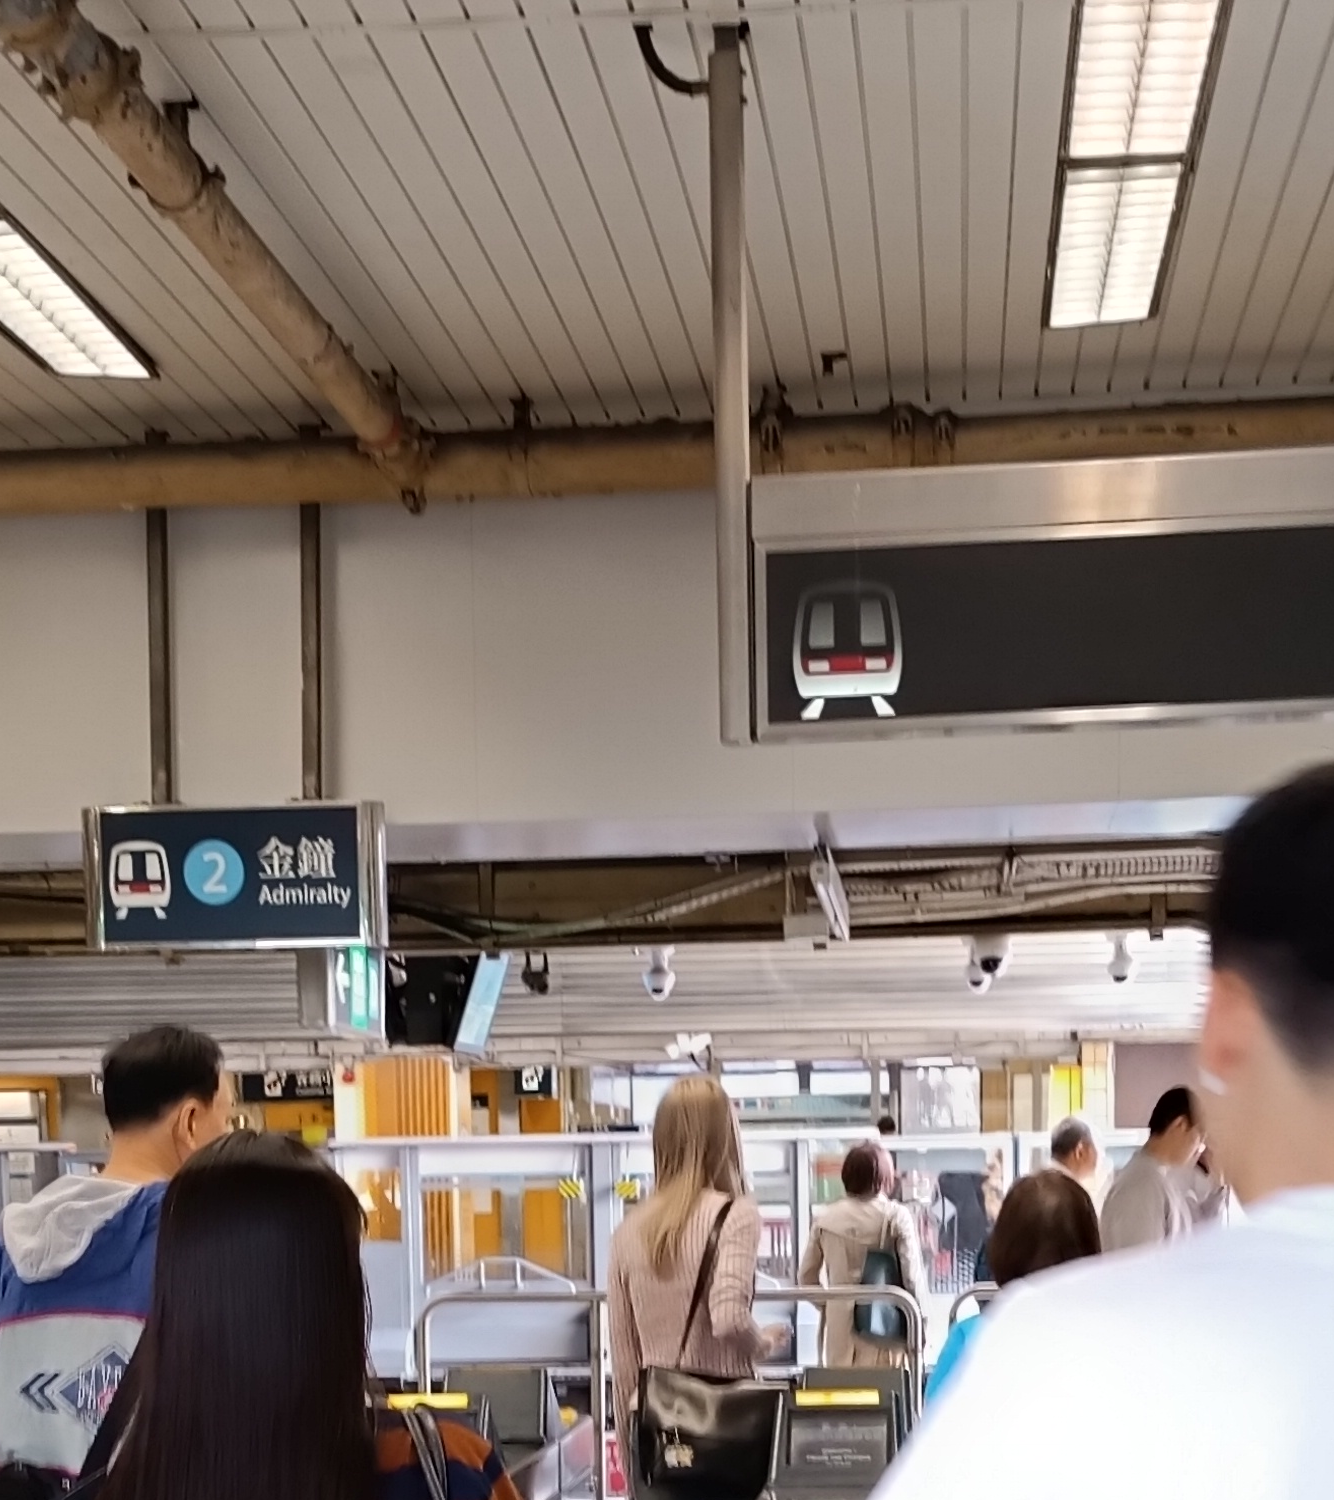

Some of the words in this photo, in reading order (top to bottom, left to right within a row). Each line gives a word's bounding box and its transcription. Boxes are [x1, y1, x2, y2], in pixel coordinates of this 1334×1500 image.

[201, 851, 228, 894] 2
[257, 835, 337, 880] 金鐘
[259, 883, 352, 909] Admiralty
